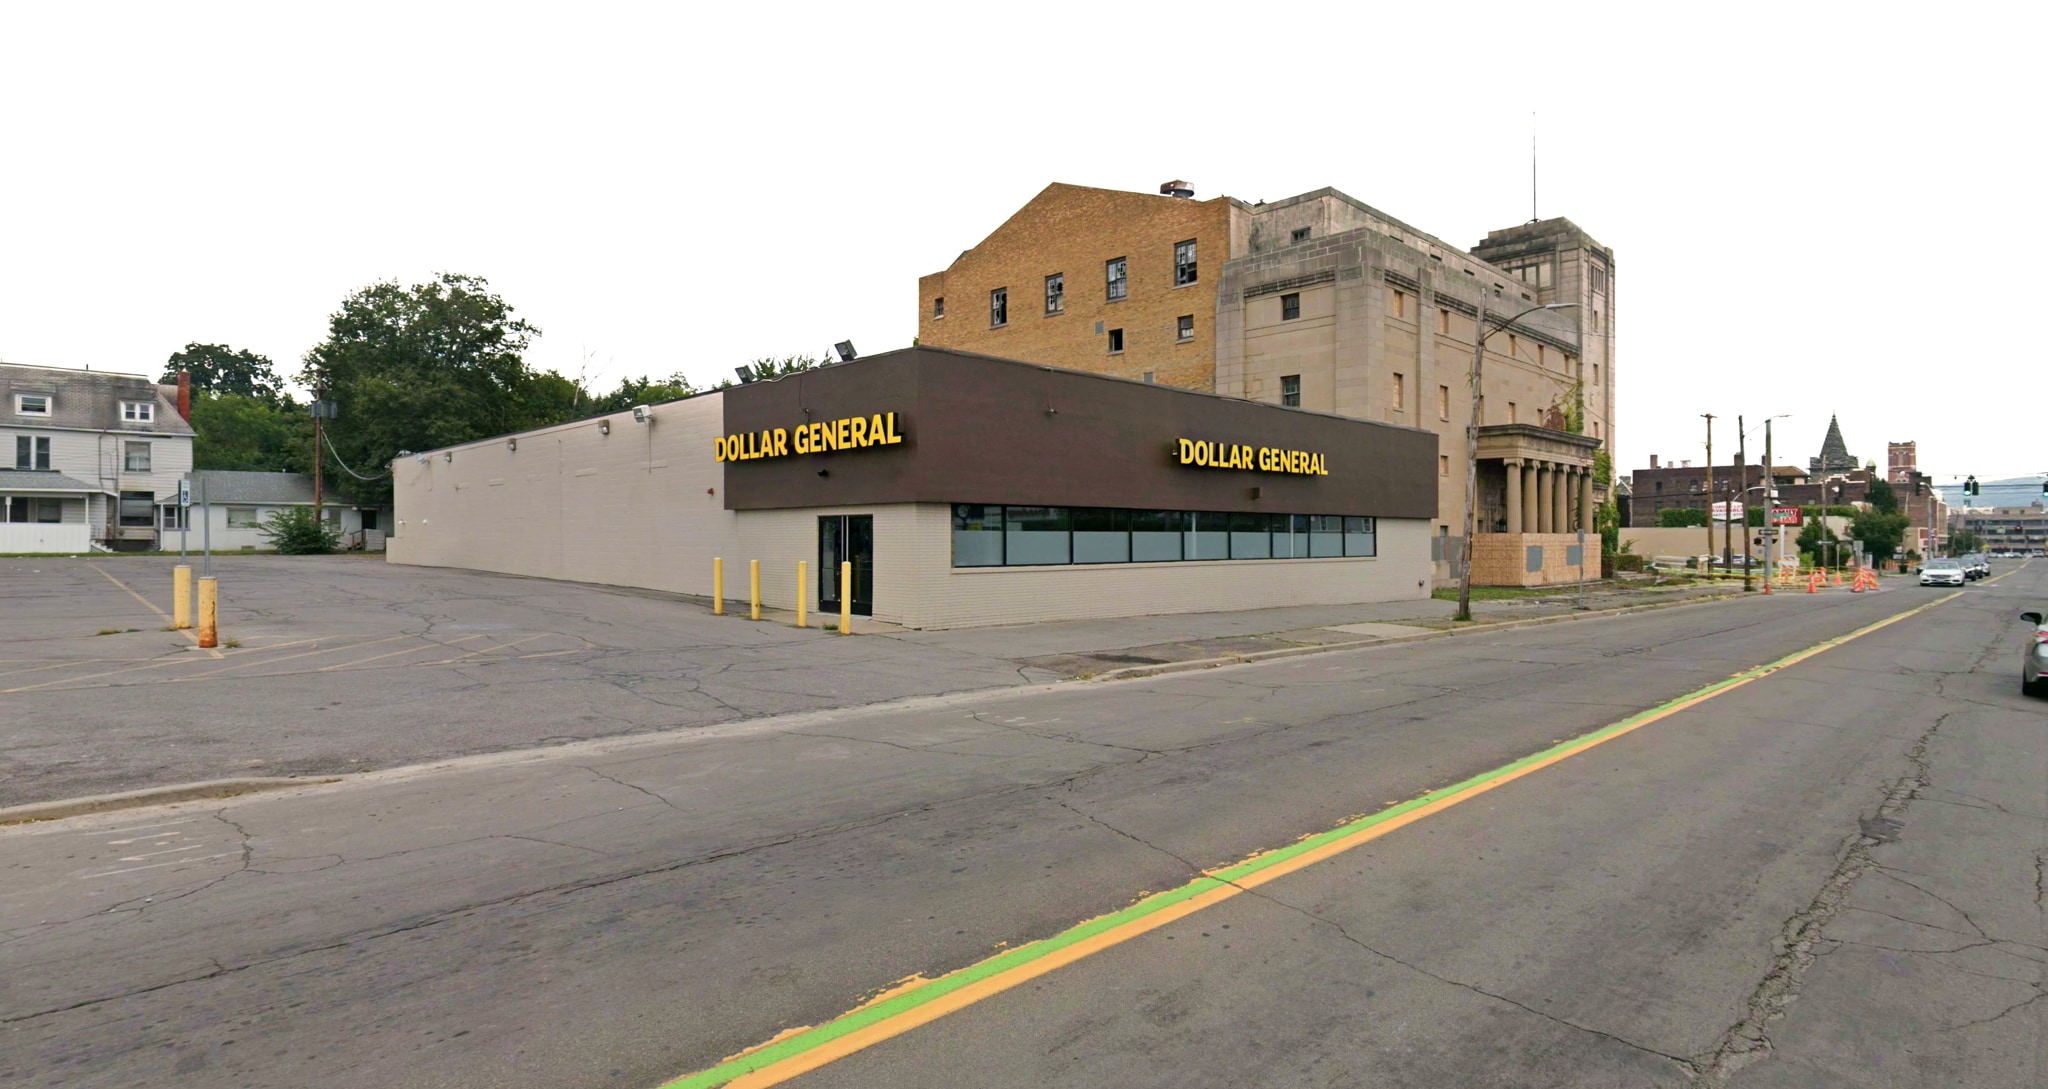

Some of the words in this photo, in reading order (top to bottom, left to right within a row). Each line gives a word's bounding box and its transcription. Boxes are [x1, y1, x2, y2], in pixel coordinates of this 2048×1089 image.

[714, 428, 788, 462] DOLLAR
[794, 412, 902, 454] GENERAL
[1179, 438, 1254, 470] DOLLAR
[1258, 447, 1329, 476] GENERAL
